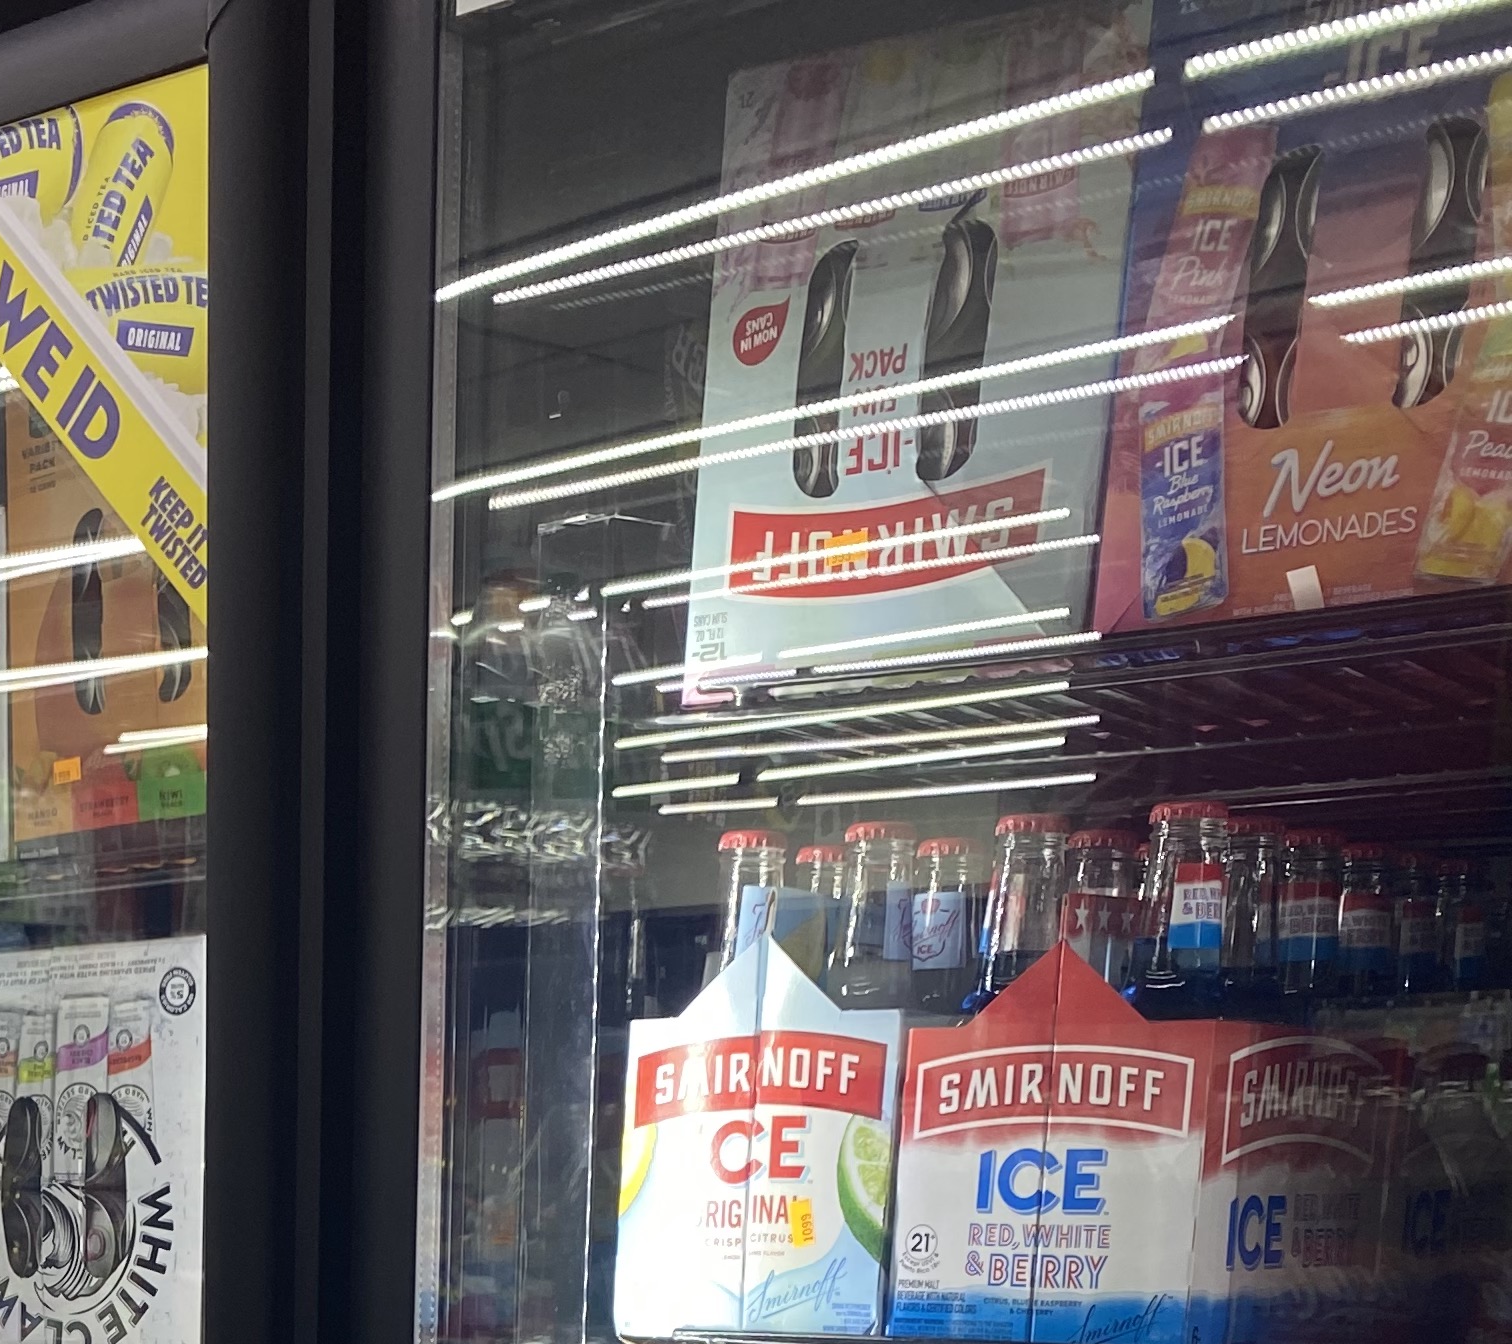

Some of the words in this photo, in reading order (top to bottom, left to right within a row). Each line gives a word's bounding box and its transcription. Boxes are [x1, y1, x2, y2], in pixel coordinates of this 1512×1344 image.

[85, 276, 179, 318] TWISTED
[127, 327, 181, 351] ORIGINAL
[849, 343, 908, 380] PACK
[55, 364, 121, 459] ID
[1152, 485, 1214, 516] Raspberry
[1264, 440, 1400, 518] Neon
[149, 476, 194, 529] KEEP
[189, 523, 207, 553] IT
[1242, 508, 1418, 555] LEMONADES
[141, 501, 207, 590] TWISTED
[654, 1049, 859, 1104] SMIRNOFF
[938, 1063, 1165, 1114] SMIRNOFF
[976, 1148, 1110, 1214] ICE
[750, 1232, 794, 1244] CITRUS
[801, 1213, 814, 1242] 1099
[968, 1223, 1020, 1250] RED,
[1022, 1224, 1111, 1248] WHITE
[965, 1250, 984, 1277] &
[988, 1254, 1108, 1290] BERRY
